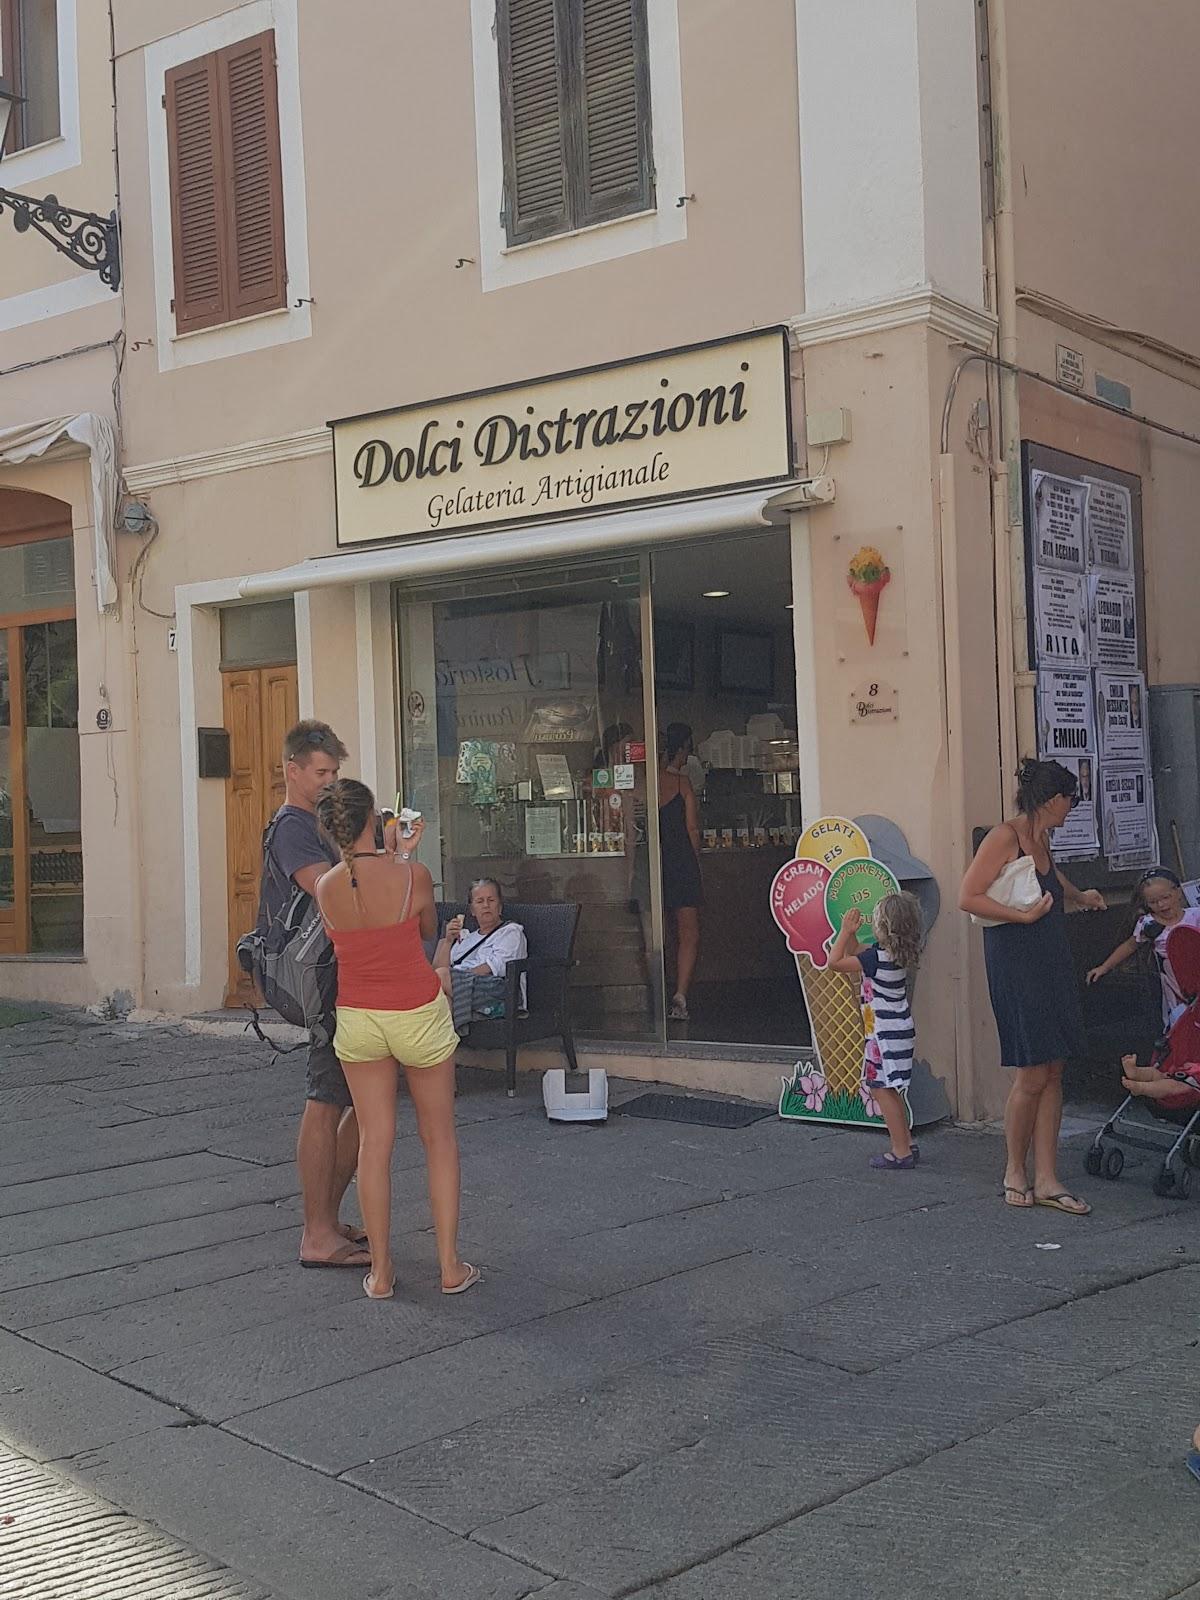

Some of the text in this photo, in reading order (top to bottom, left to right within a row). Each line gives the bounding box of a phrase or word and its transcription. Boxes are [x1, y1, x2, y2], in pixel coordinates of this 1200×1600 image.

[353, 362, 749, 489] Dolci Distrazioni
[428, 452, 670, 528] Gelateria Artigianale
[169, 633, 176, 647] 7
[1046, 633, 1079, 656] RITA
[868, 683, 879, 697] 8
[100, 710, 106, 721] 6
[1053, 727, 1088, 749] EMILIO
[811, 823, 855, 839] GELATI
[823, 845, 843, 863] EIS
[774, 863, 824, 907] ICE CREAM
[784, 880, 825, 918] HELADO
[851, 888, 871, 904] IJS
